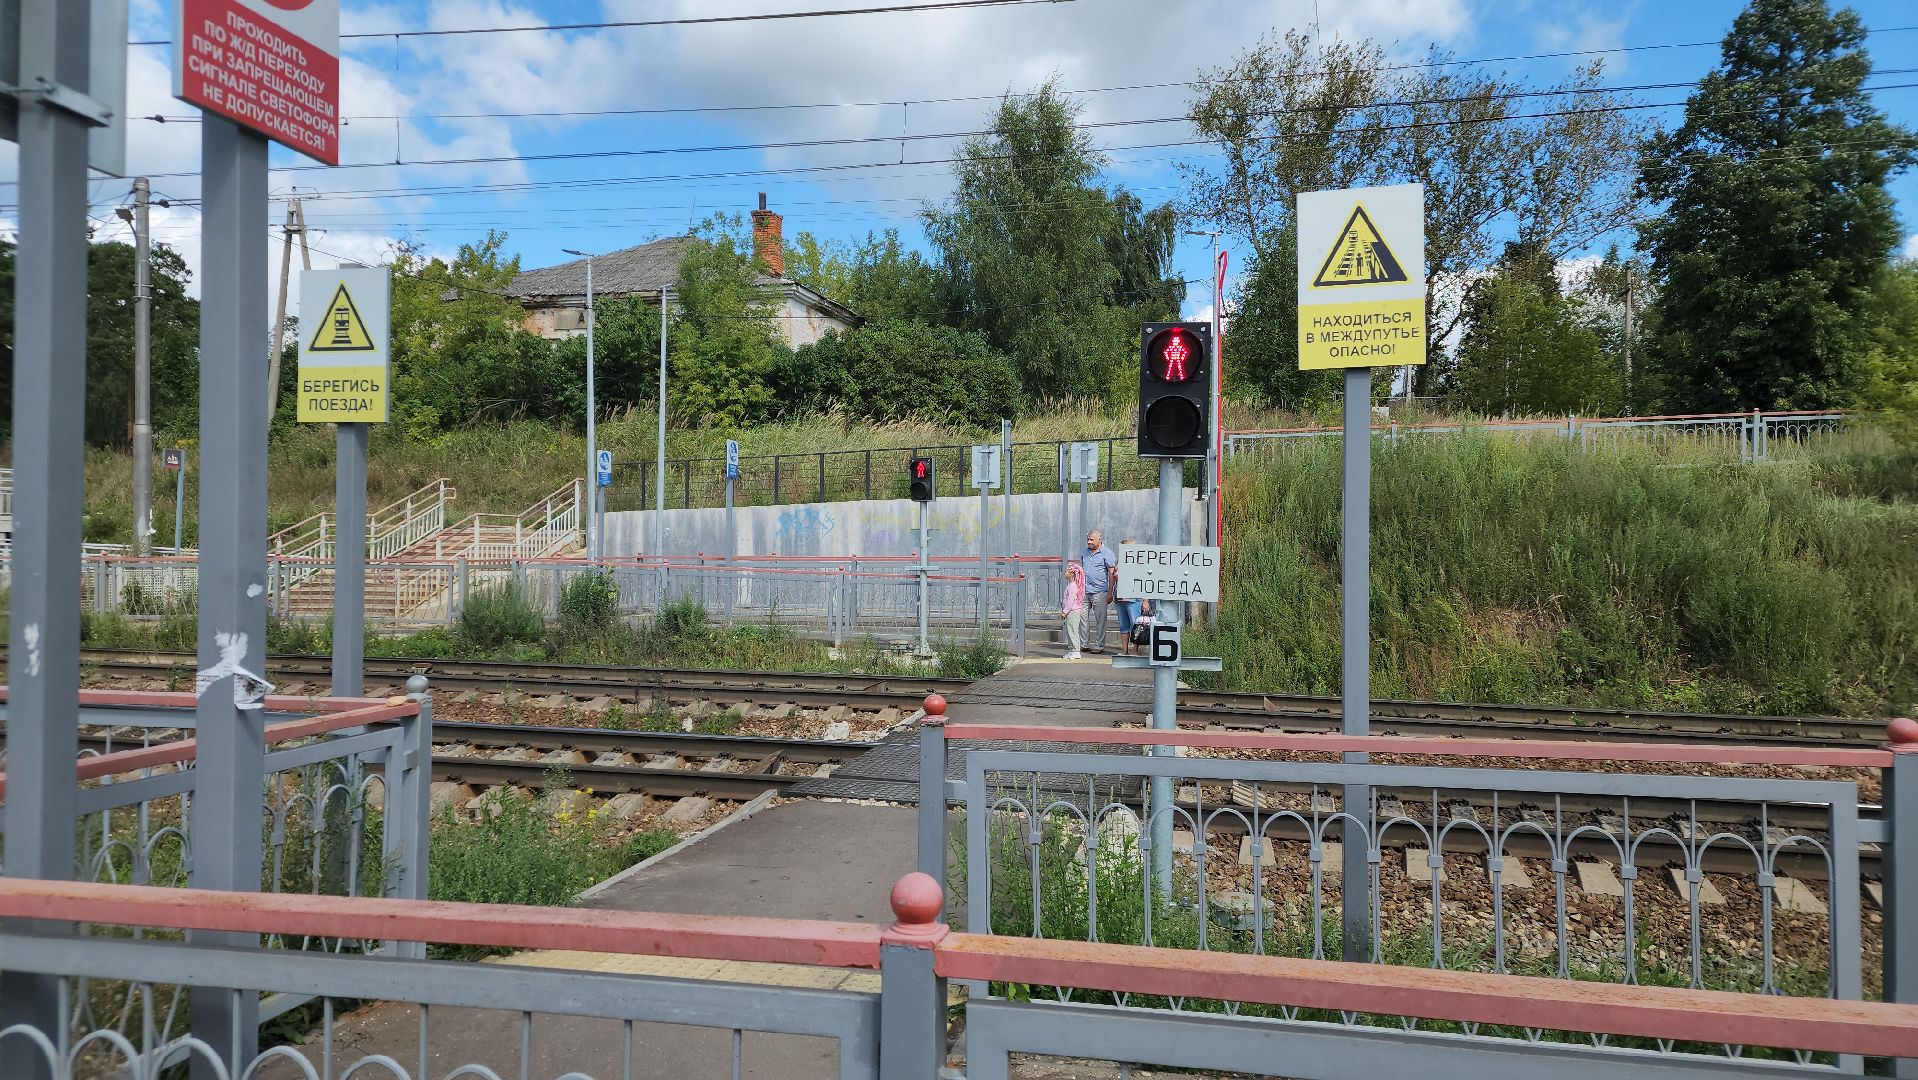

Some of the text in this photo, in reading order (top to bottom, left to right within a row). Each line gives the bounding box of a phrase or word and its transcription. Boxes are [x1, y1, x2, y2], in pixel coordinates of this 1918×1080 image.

[227, 11, 307, 66] ПРОХОДИТЬ
[204, 20, 325, 93] ПО Ж/Д ПЕРЕХОДУ
[192, 34, 333, 117] ПРИ ЗАПРЕЩАЮЩЕМ
[188, 55, 336, 137] СИГНАЛЕ СВЕТОФОРА
[203, 83, 325, 151] НЕ ДОПУСКАЕТСЯ!
[1313, 312, 1412, 328] НАХОДИТЬСЯ
[1306, 327, 1419, 343] В МЕЖДУПУТЬЕ
[1330, 344, 1395, 357] ОПАСНО!
[303, 379, 379, 393] БЕРЕГИСЬ
[309, 399, 373, 413] ПОЕЗДА!
[1125, 550, 1213, 566] БЕРЕГИСЬ
[1133, 579, 1202, 596] ПОЕЗДА
[1153, 626, 1178, 661] Б
